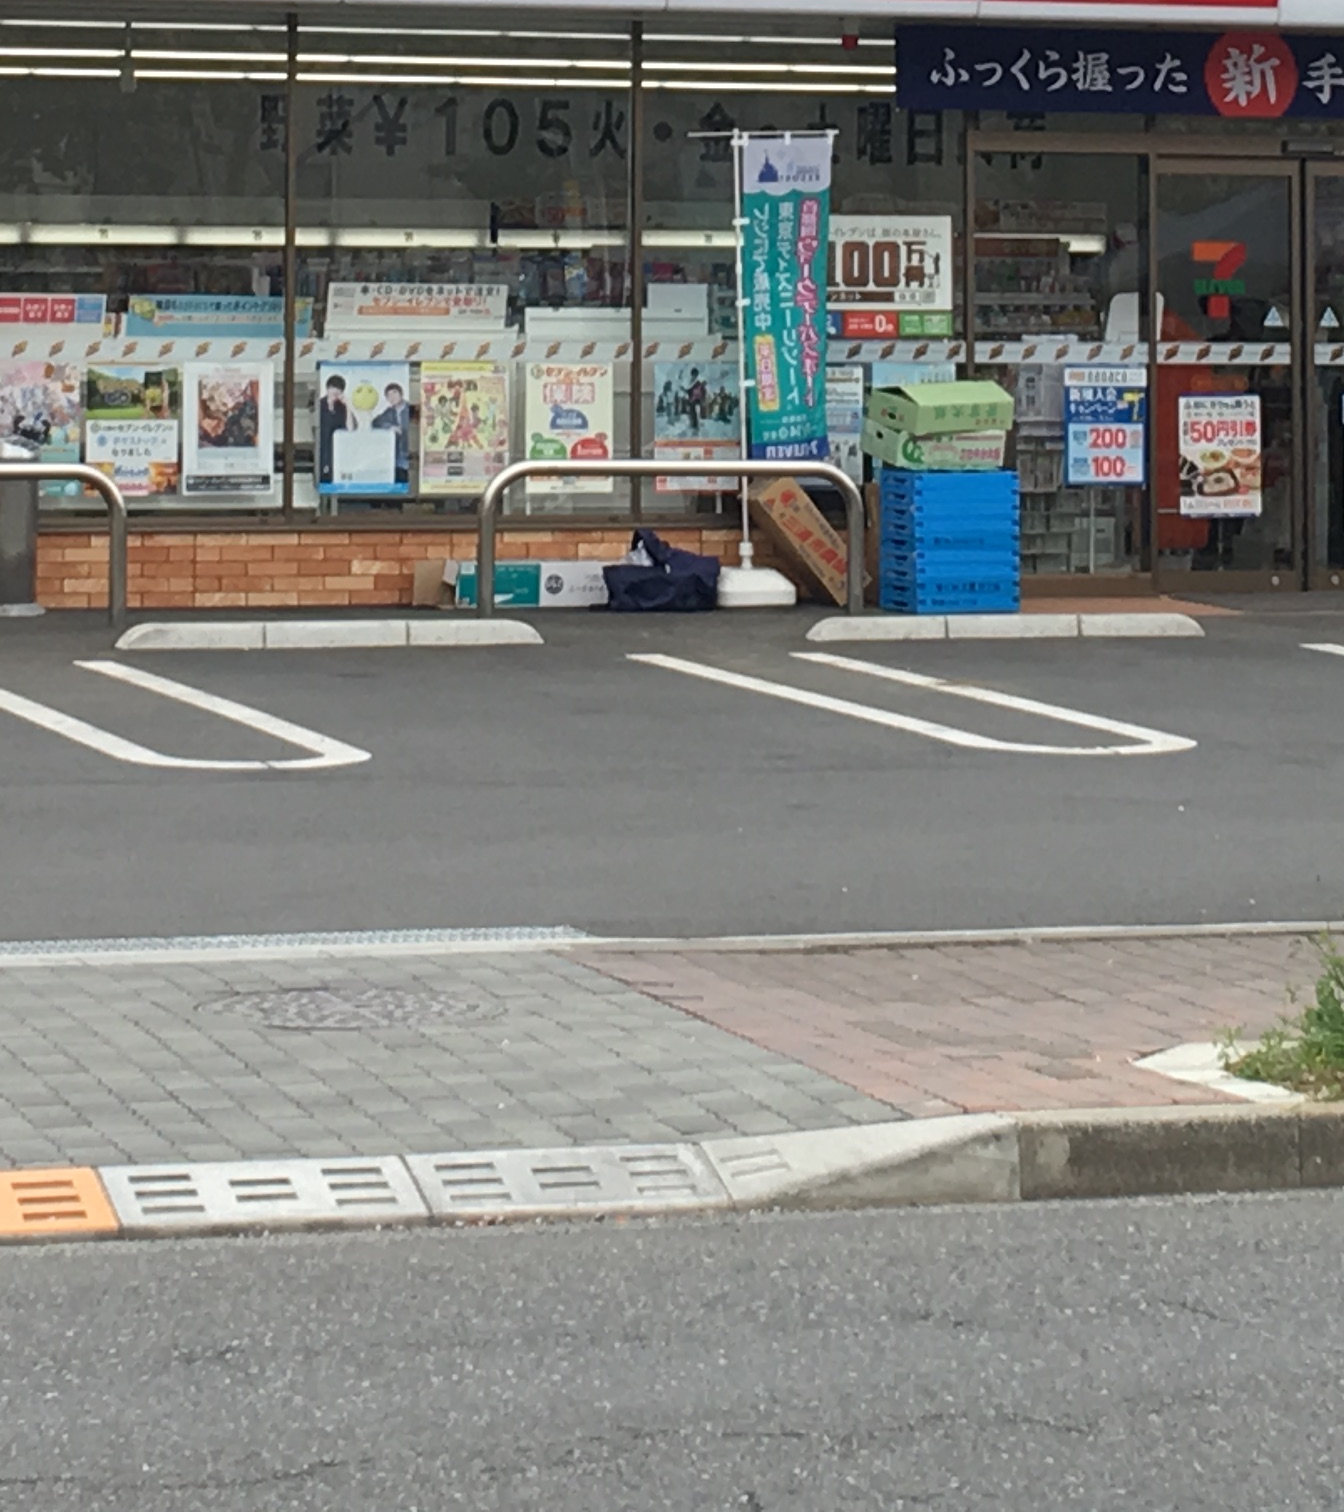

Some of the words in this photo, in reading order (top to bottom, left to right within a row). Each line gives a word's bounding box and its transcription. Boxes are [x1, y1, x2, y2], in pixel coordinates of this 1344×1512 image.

[930, 47, 1188, 93] ふっくら握った
[1221, 44, 1281, 107] 新
[1089, 428, 1127, 449] 200
[1091, 456, 1126, 477] 100
